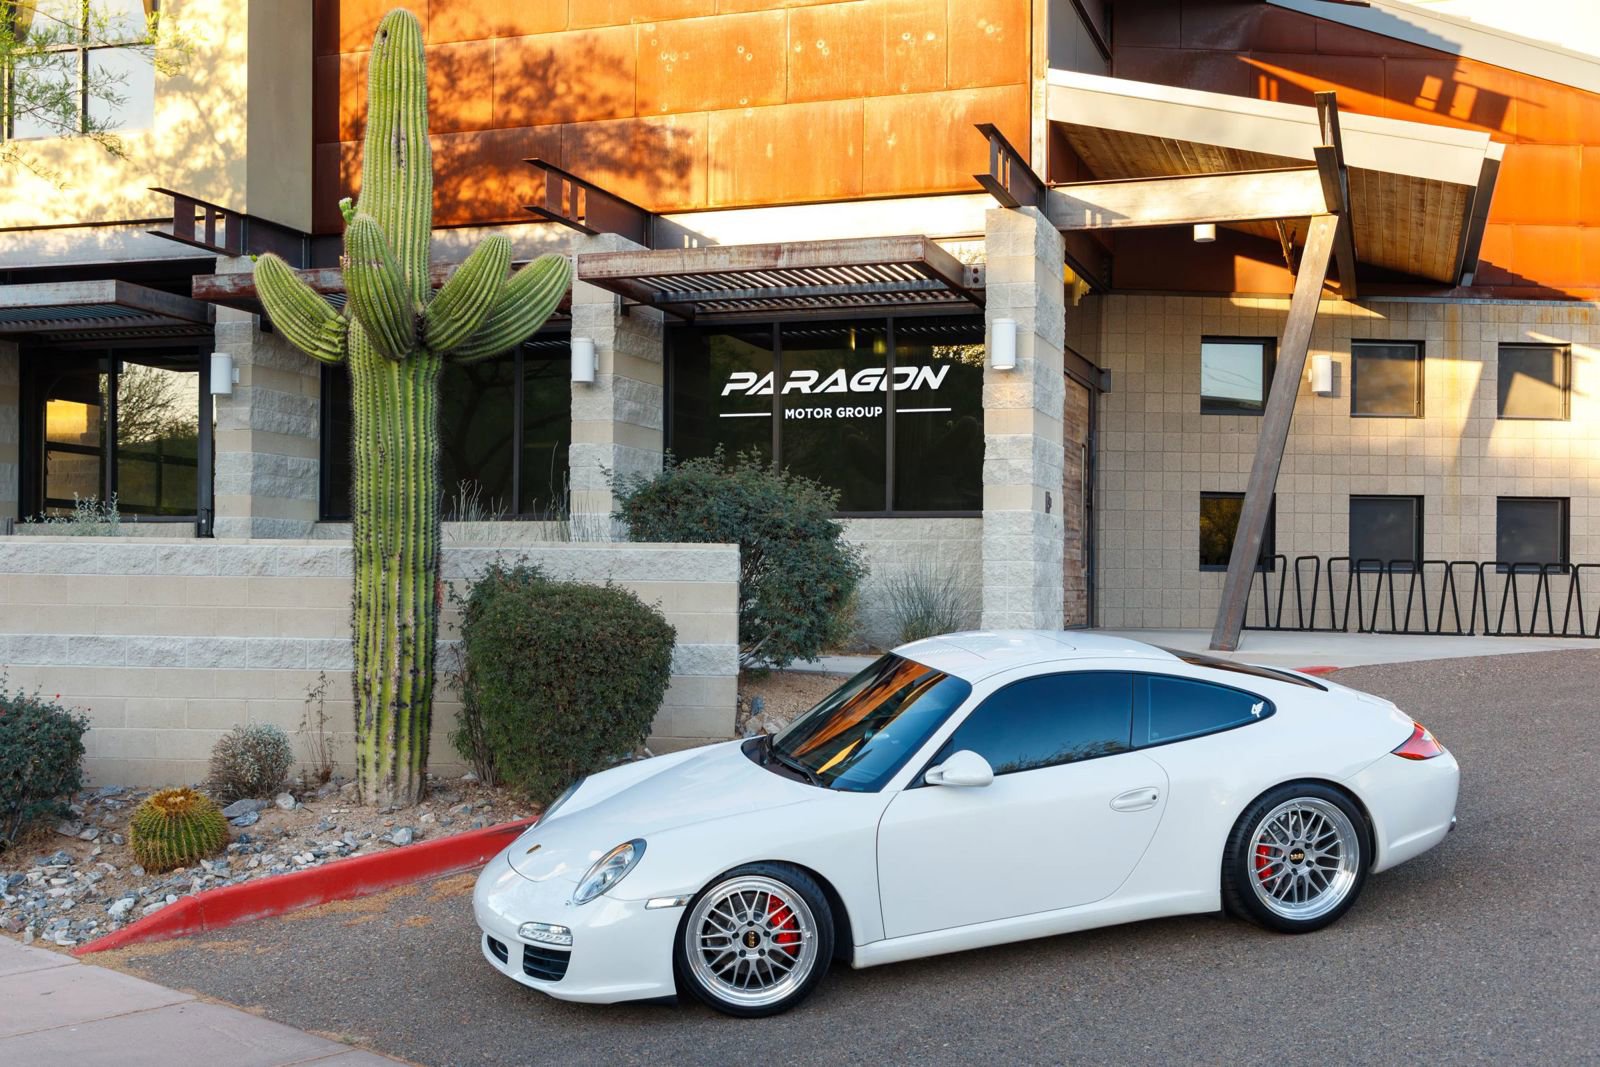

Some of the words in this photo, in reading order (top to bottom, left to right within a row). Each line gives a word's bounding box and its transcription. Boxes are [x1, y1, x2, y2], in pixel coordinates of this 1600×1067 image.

[720, 364, 951, 397] PARAGON
[784, 407, 833, 420] MOTOR
[835, 406, 883, 419] GROUP
